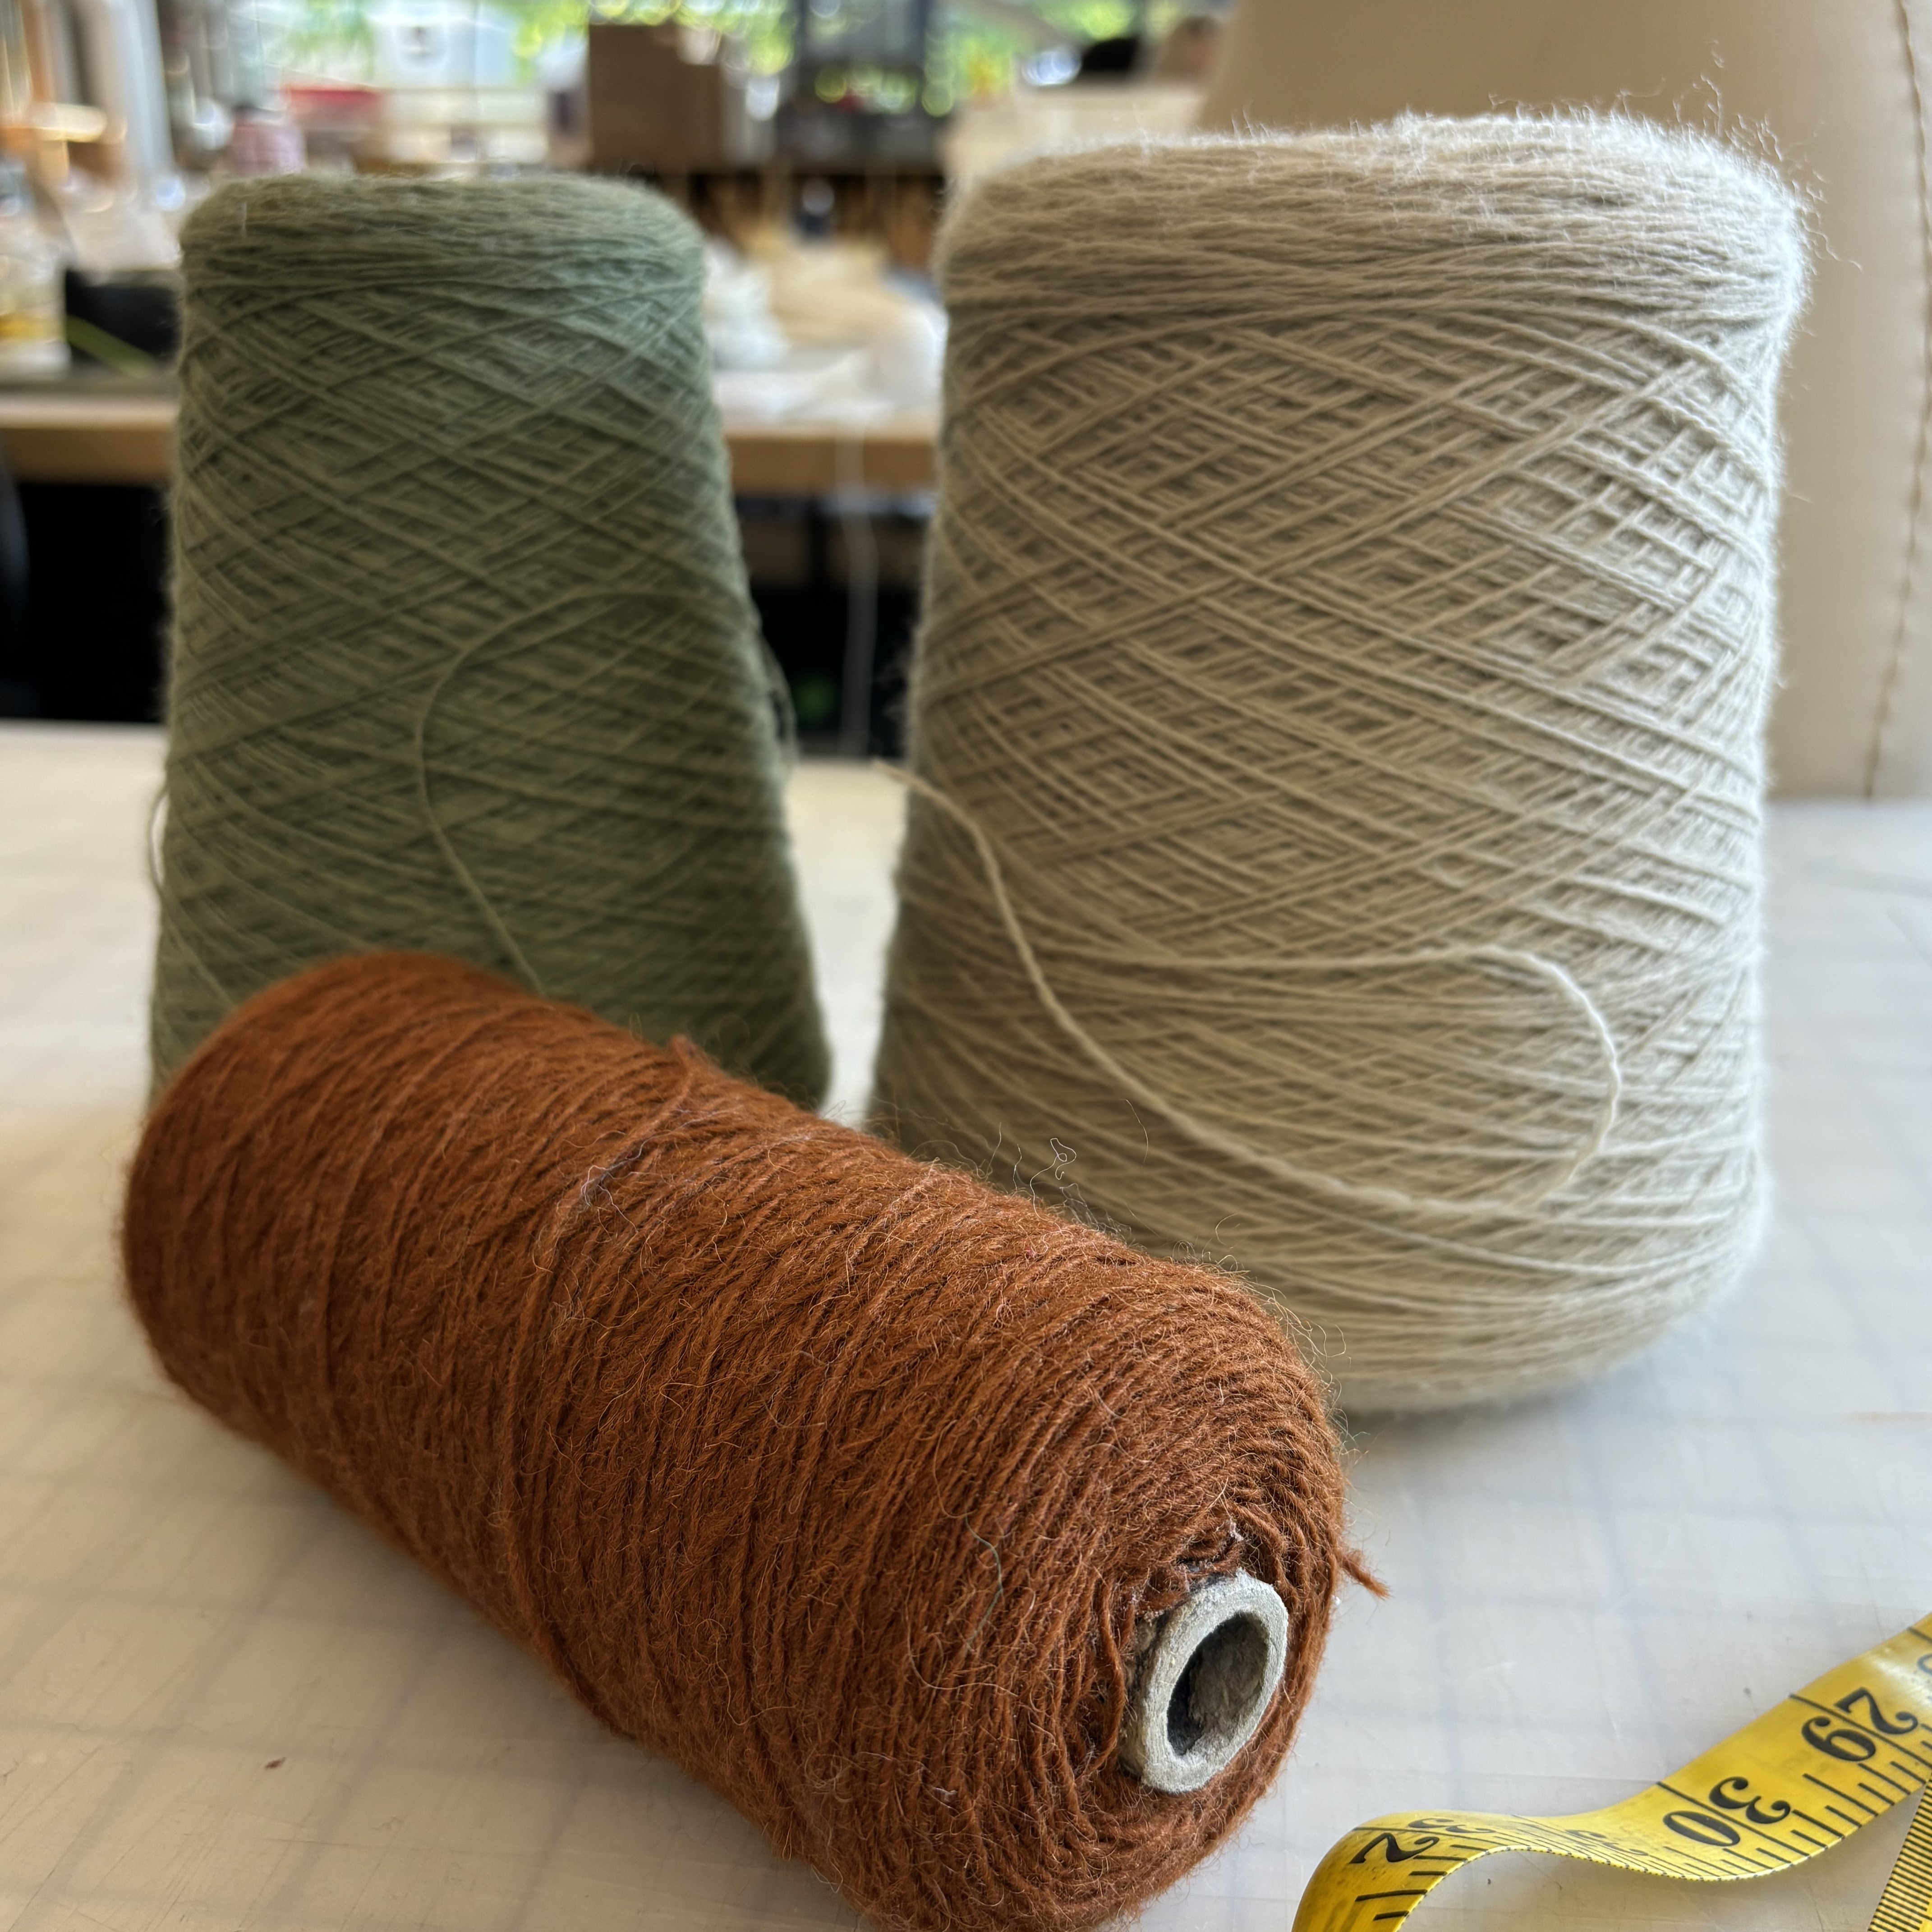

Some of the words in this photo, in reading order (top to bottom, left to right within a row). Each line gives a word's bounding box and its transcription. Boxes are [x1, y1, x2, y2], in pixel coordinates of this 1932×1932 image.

[1801, 1686, 1918, 1762] 29
[1348, 1818, 1497, 1863] 32
[1663, 1776, 1790, 1846] 30
